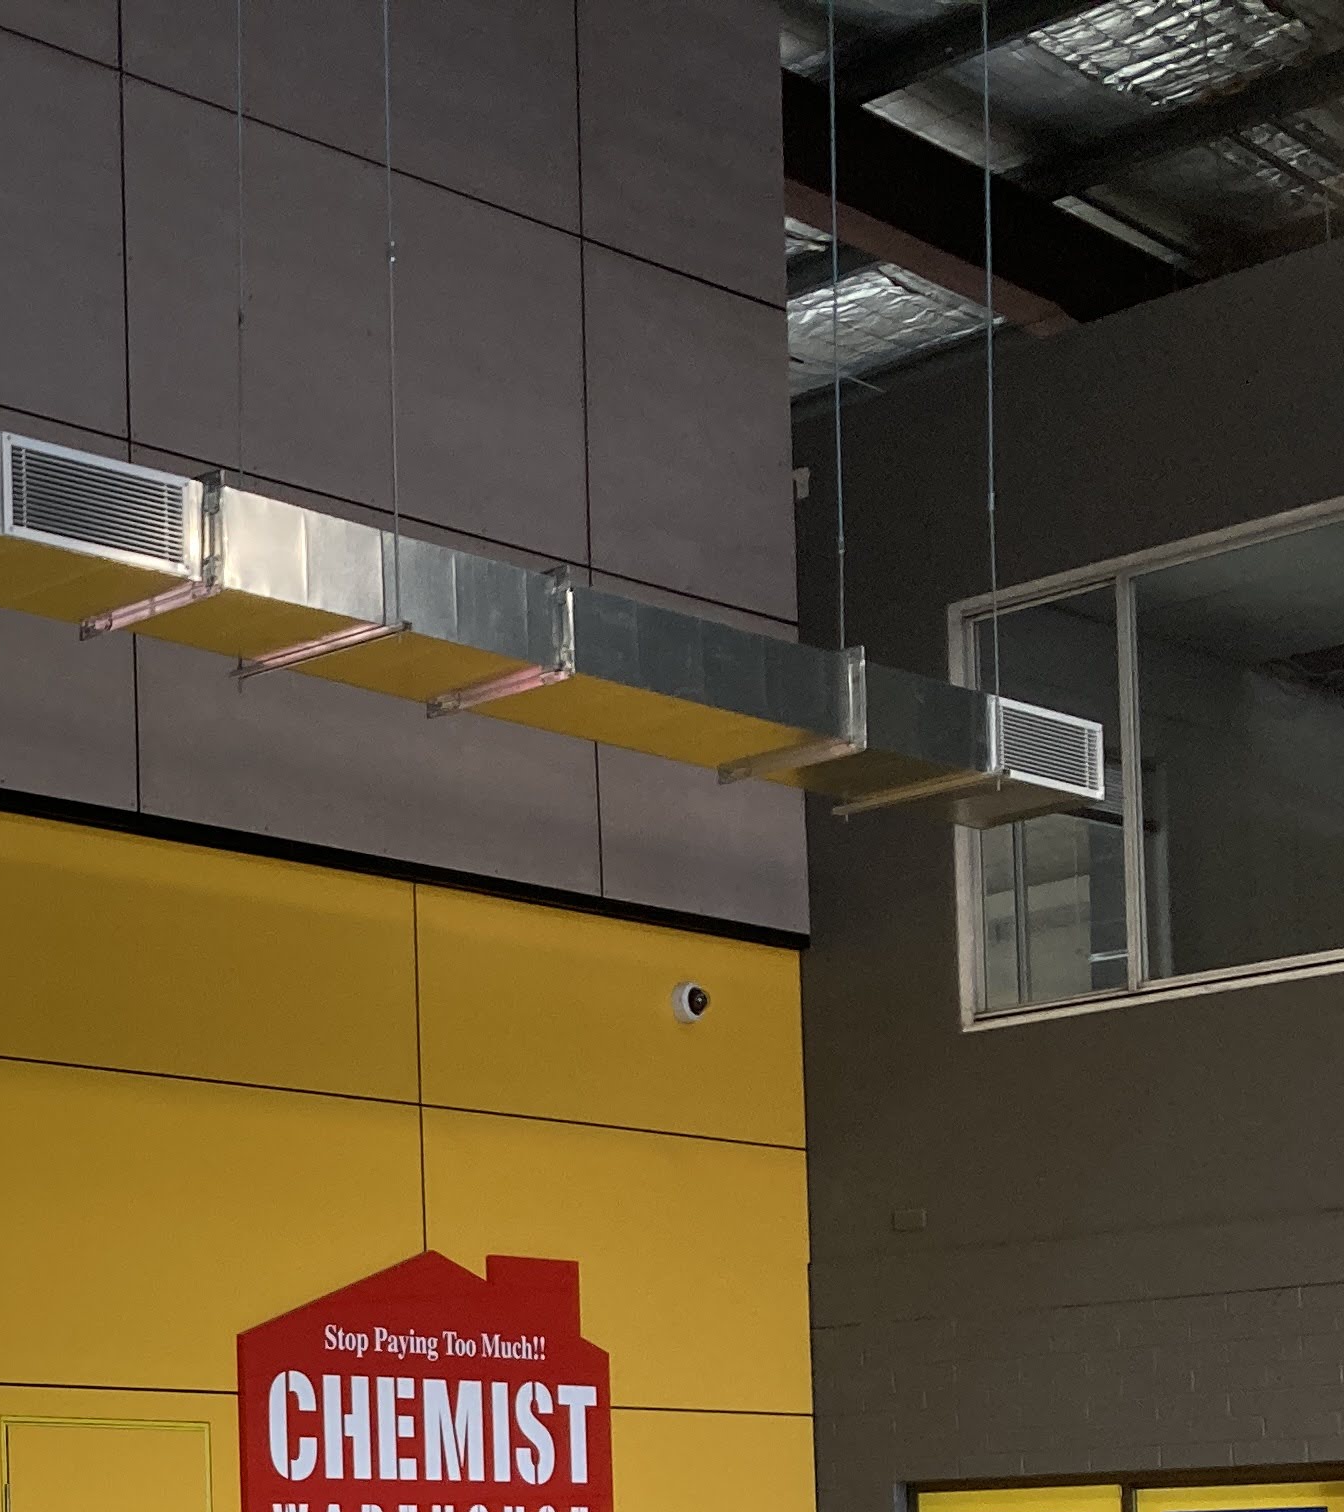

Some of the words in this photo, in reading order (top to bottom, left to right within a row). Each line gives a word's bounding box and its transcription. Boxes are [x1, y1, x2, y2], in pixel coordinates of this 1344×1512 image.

[324, 1323, 369, 1357] Stop
[374, 1327, 439, 1361] Paying
[442, 1331, 476, 1358] Too
[481, 1333, 546, 1361] Much!!
[268, 1370, 598, 1485] CHEMIST
